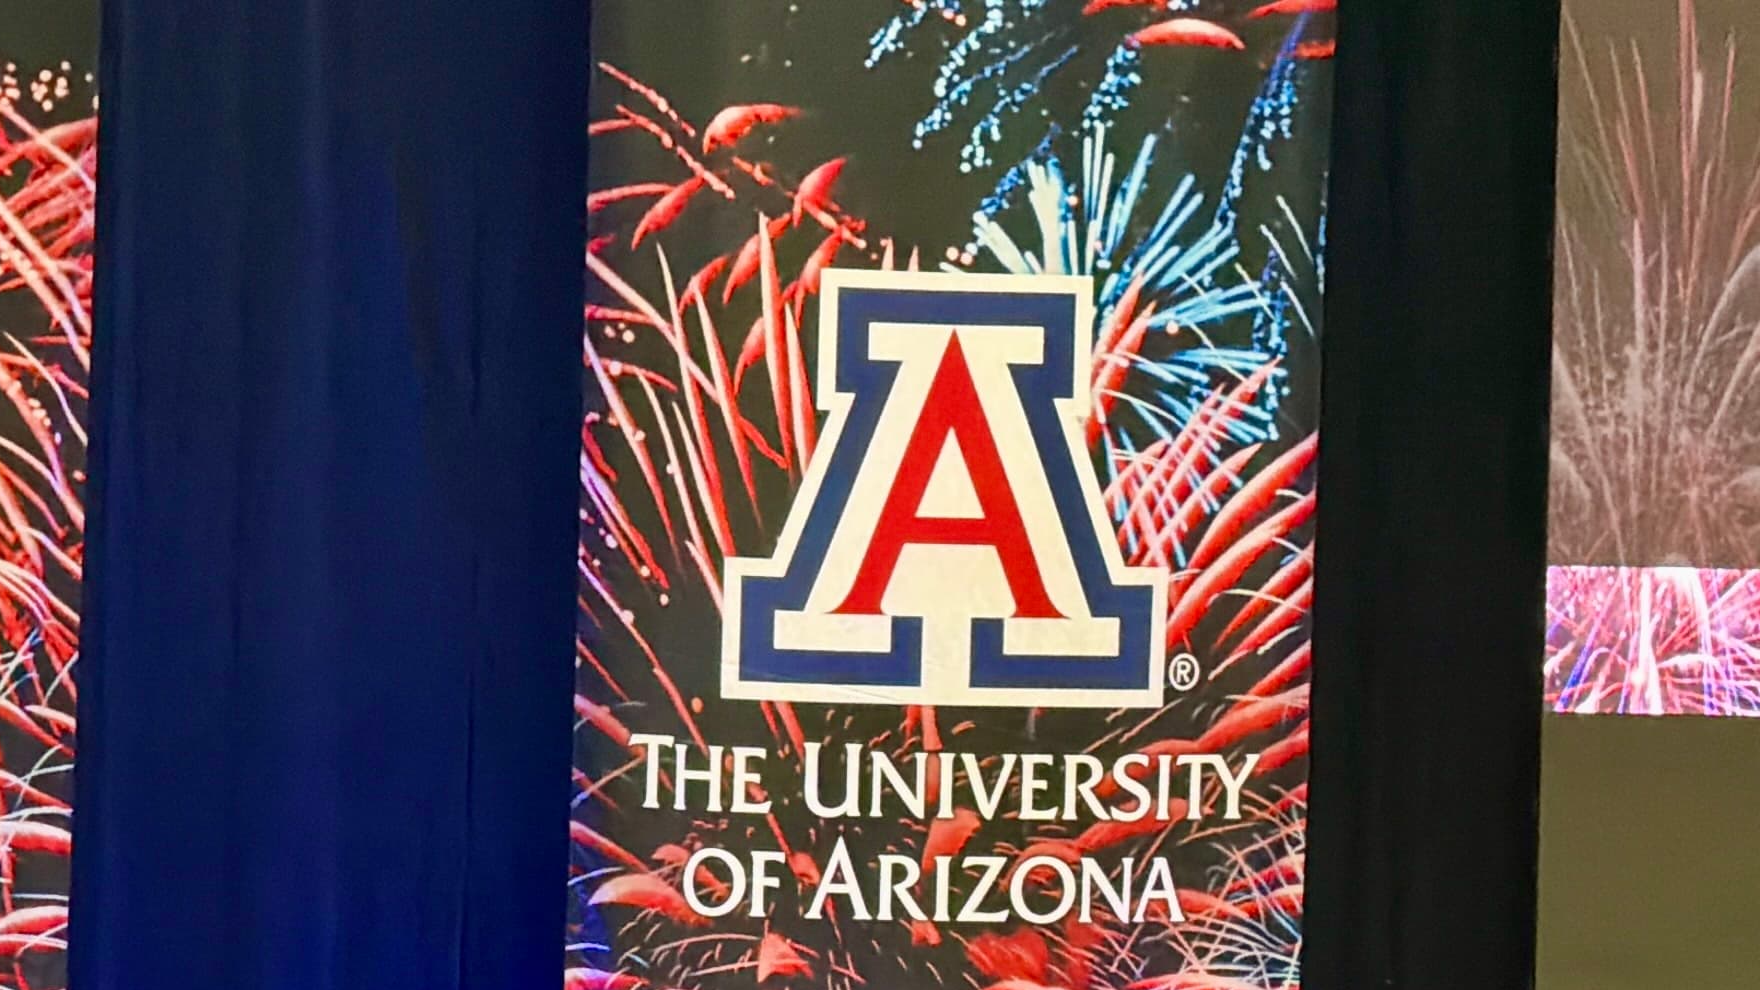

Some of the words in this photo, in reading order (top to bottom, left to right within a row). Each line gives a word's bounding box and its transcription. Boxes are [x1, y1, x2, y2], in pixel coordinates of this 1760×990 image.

[721, 268, 1169, 708] A
[628, 733, 773, 815] THE
[802, 741, 1261, 822] UNIVERSITY
[681, 846, 787, 919] OF
[803, 836, 1186, 924] ARIZONA
